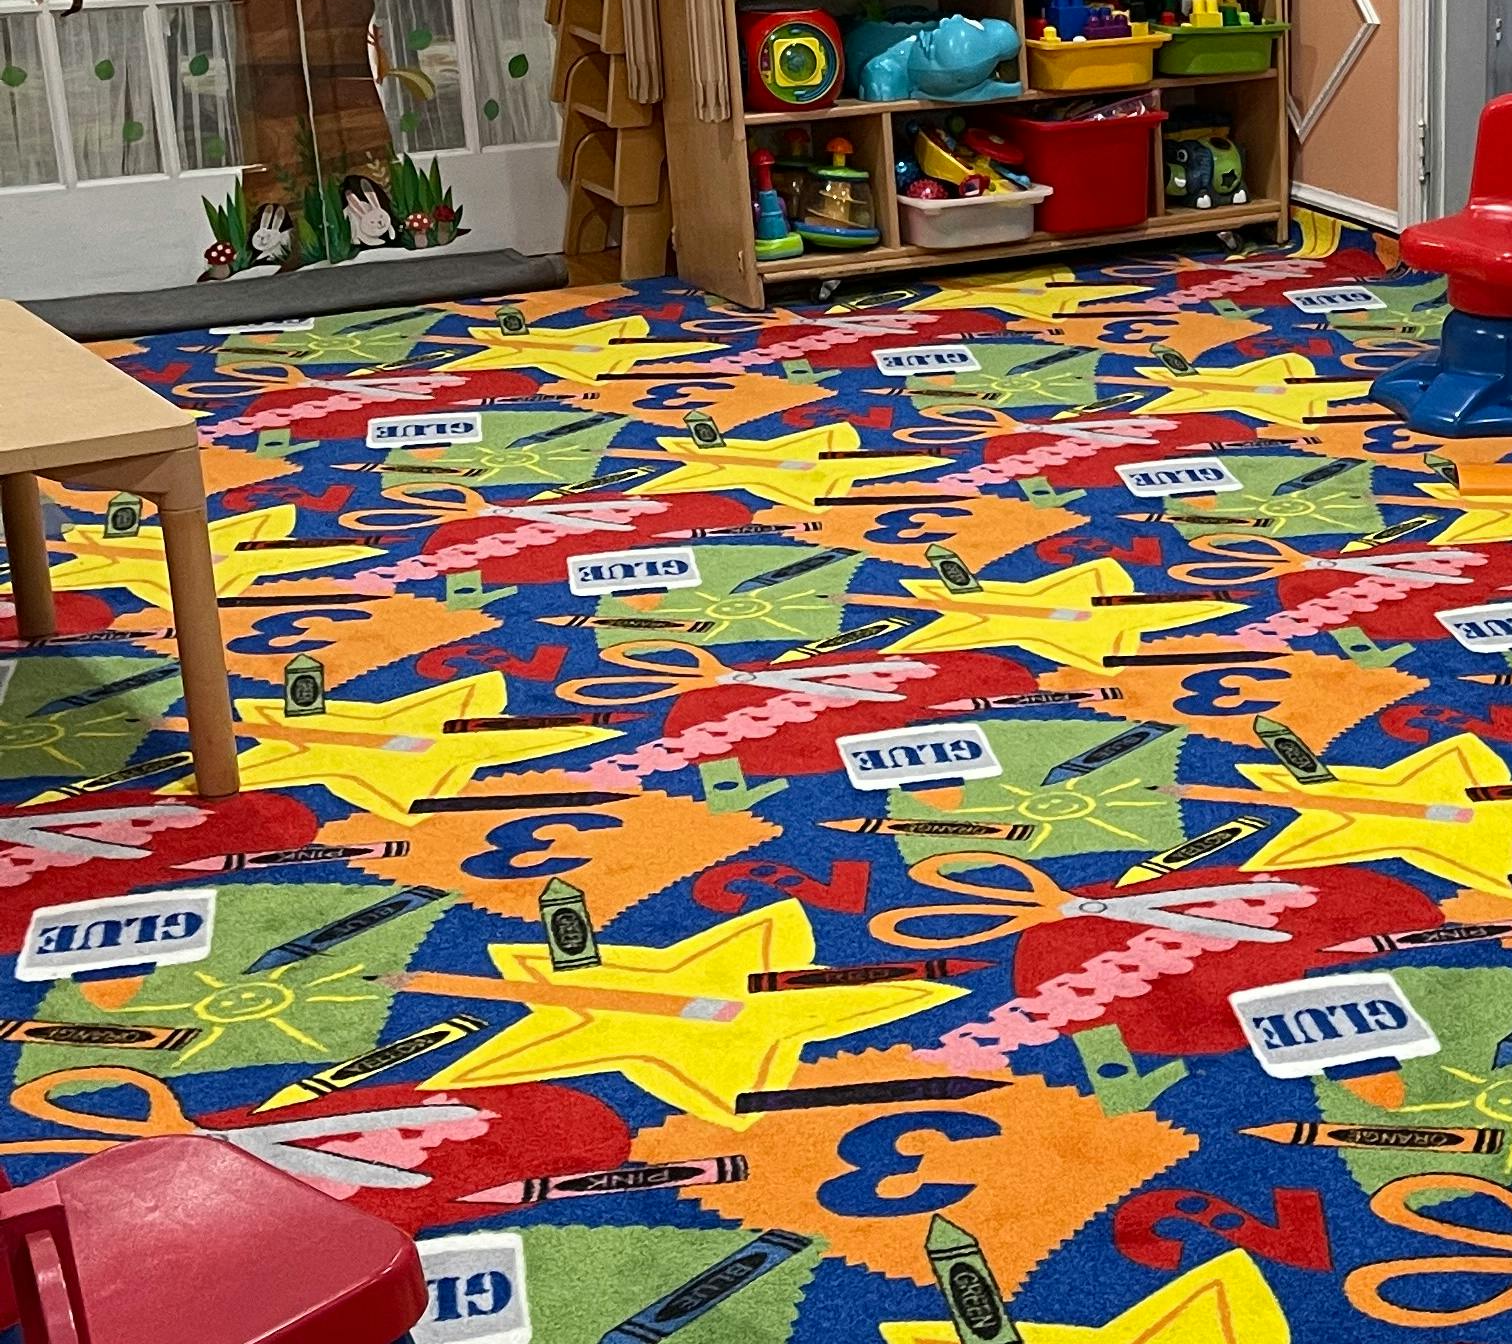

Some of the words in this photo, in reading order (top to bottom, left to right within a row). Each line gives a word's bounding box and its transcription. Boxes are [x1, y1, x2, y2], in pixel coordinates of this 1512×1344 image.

[1295, 292, 1372, 306] GLUE
[882, 350, 970, 369] GLUE
[374, 418, 475, 439] GLUE
[1129, 464, 1224, 486] GLUE
[864, 508, 973, 542] 3
[578, 558, 689, 581] GLUE
[226, 608, 371, 654] 3
[1330, 627, 1415, 666] 1
[1172, 667, 1292, 716] 3
[853, 739, 983, 770] GLUE
[700, 758, 789, 814] 1
[276, 849, 343, 862] PINK
[462, 812, 622, 878] 3
[694, 860, 870, 914] 2
[39, 908, 203, 951] GLUE
[826, 969, 890, 984] RED
[1253, 1000, 1409, 1048] GLUE
[1073, 1024, 1189, 1117] 1
[588, 1170, 668, 1189] PINK
[816, 1112, 1003, 1216] 3
[1114, 1187, 1332, 1270] 2
[426, 1270, 511, 1320] GL
[676, 1263, 746, 1308] BLUE
